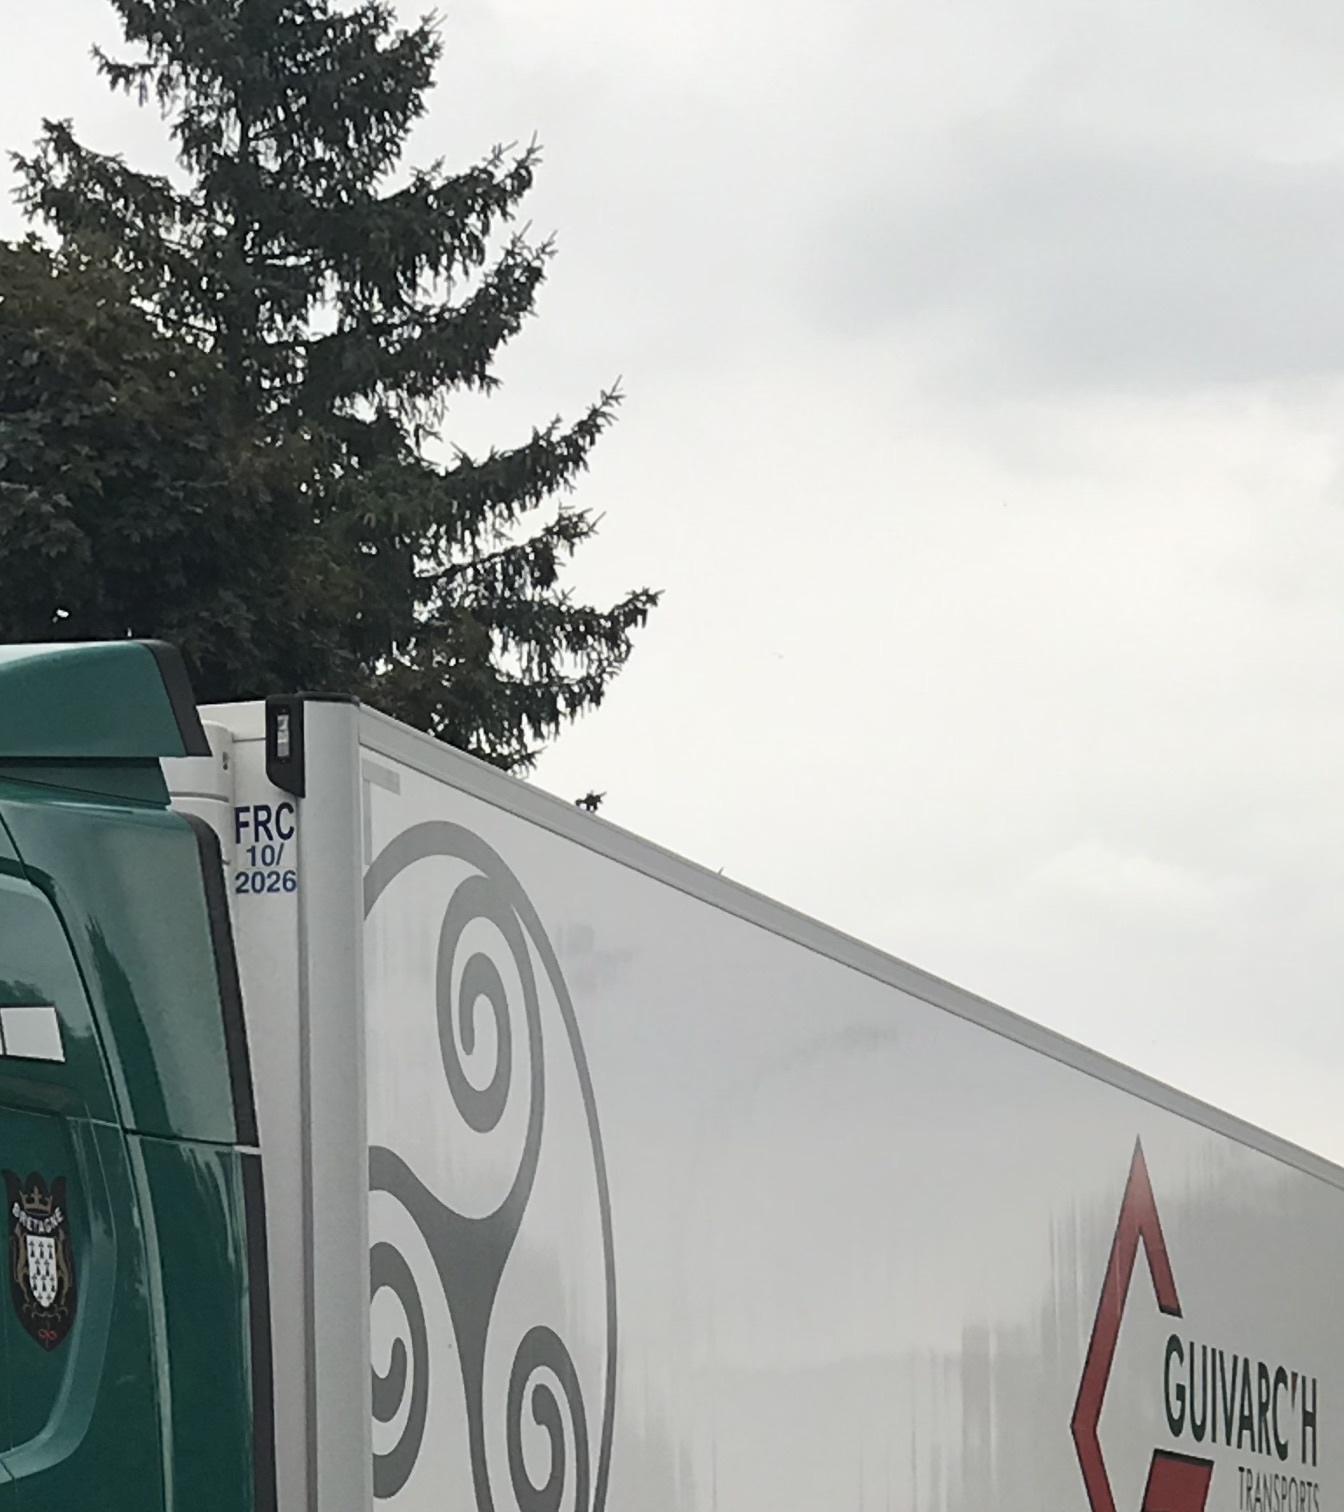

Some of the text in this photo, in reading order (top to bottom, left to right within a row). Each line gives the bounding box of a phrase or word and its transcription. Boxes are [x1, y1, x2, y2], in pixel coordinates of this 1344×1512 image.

[234, 802, 295, 844] FRC
[245, 842, 285, 868] 10/
[234, 869, 297, 894] 2026
[12, 1201, 64, 1234] BRETAGNE
[1164, 1333, 1318, 1468] GUIVARC'H
